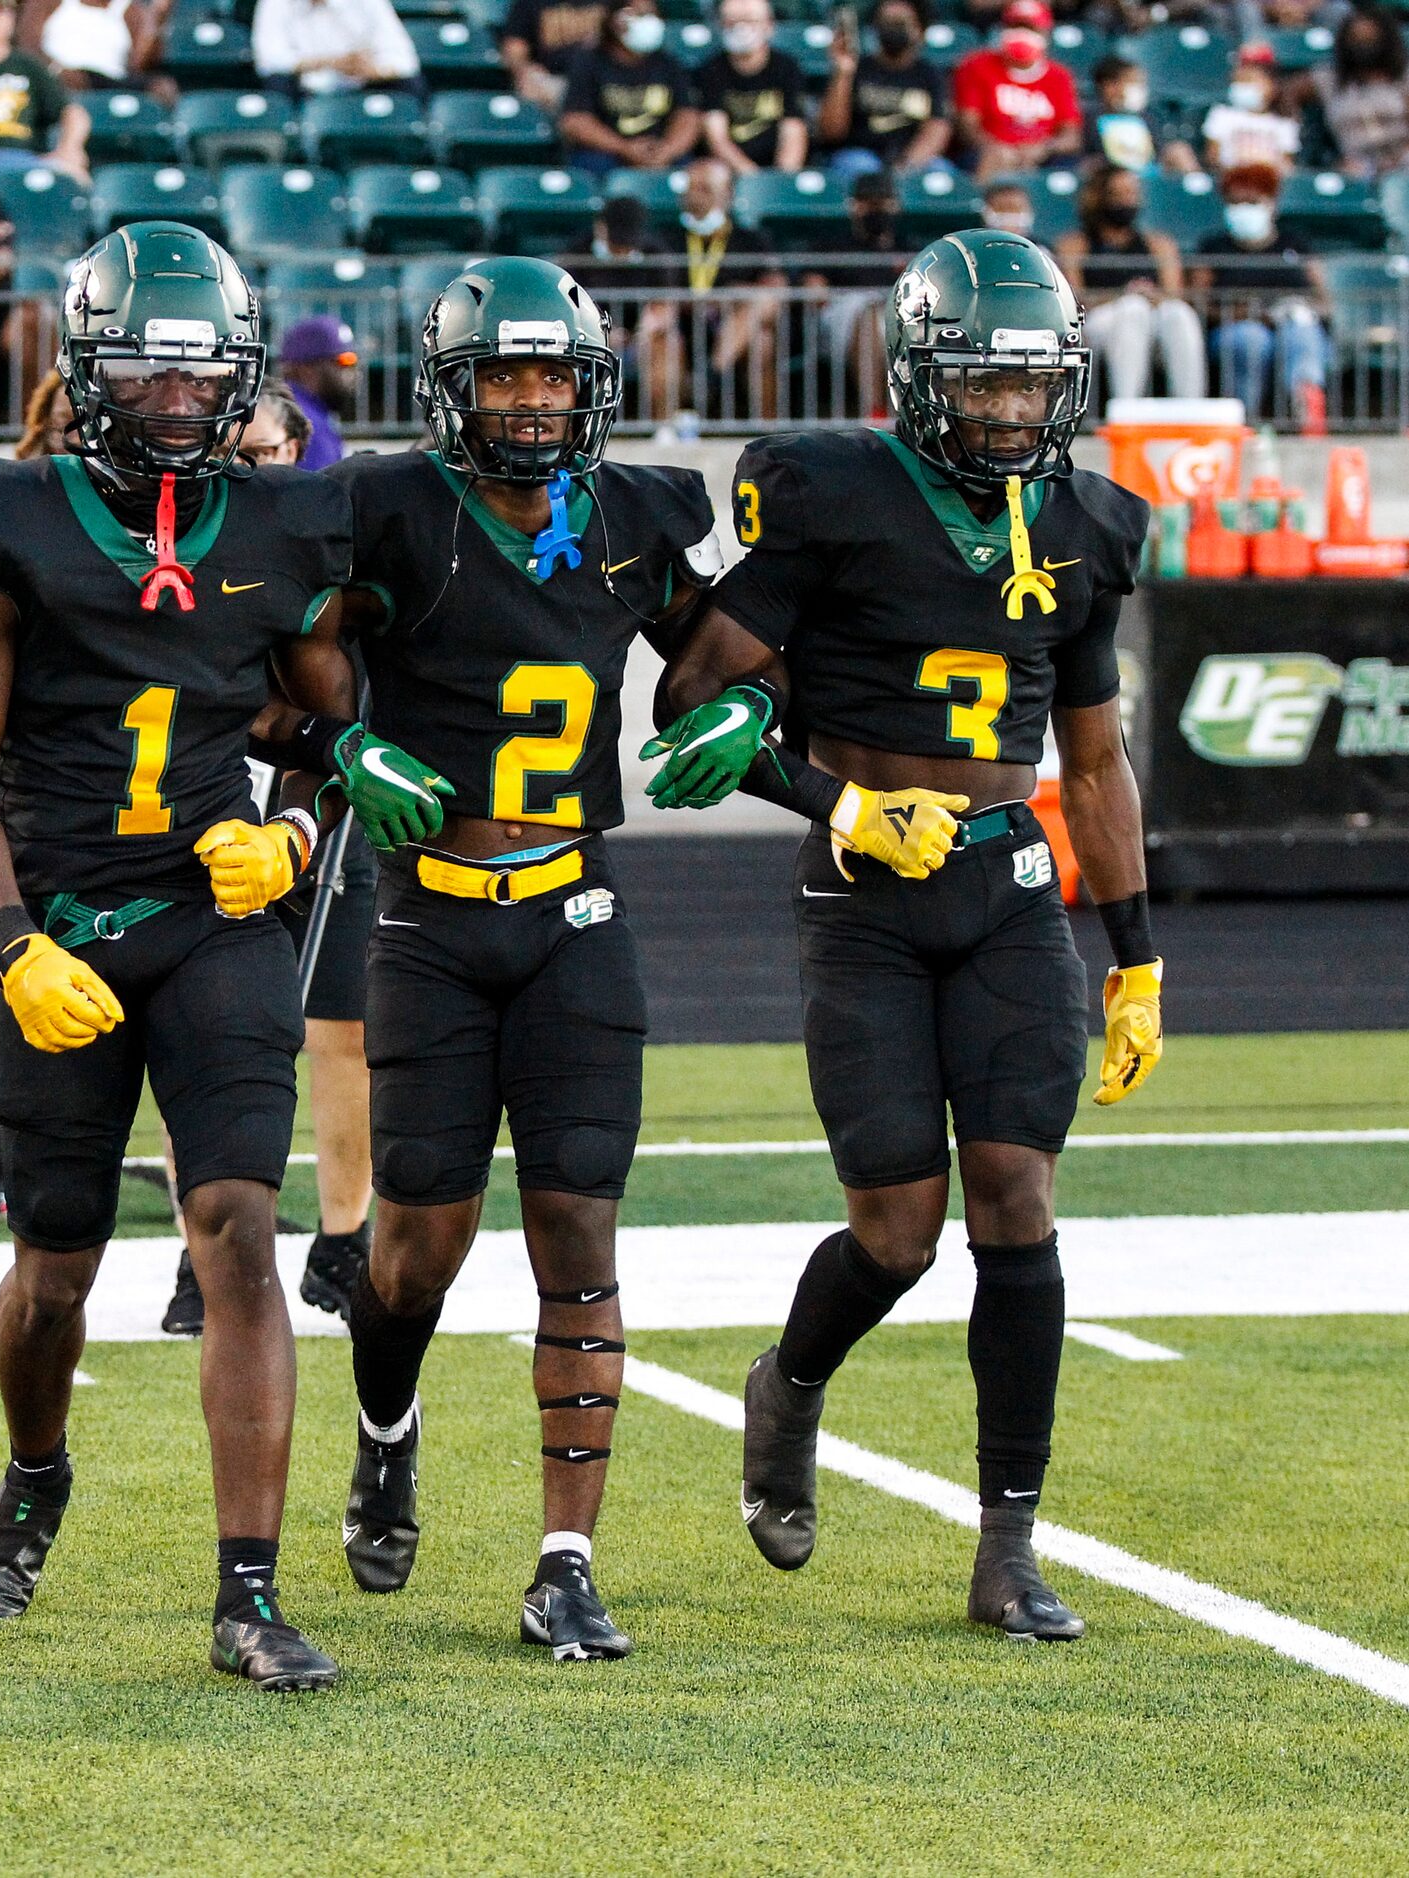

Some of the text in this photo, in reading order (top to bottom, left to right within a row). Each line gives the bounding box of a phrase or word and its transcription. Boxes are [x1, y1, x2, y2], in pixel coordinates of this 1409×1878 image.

[737, 480, 762, 544] 3
[113, 682, 181, 836] 1
[489, 661, 599, 828] 2
[914, 646, 1011, 761] 3
